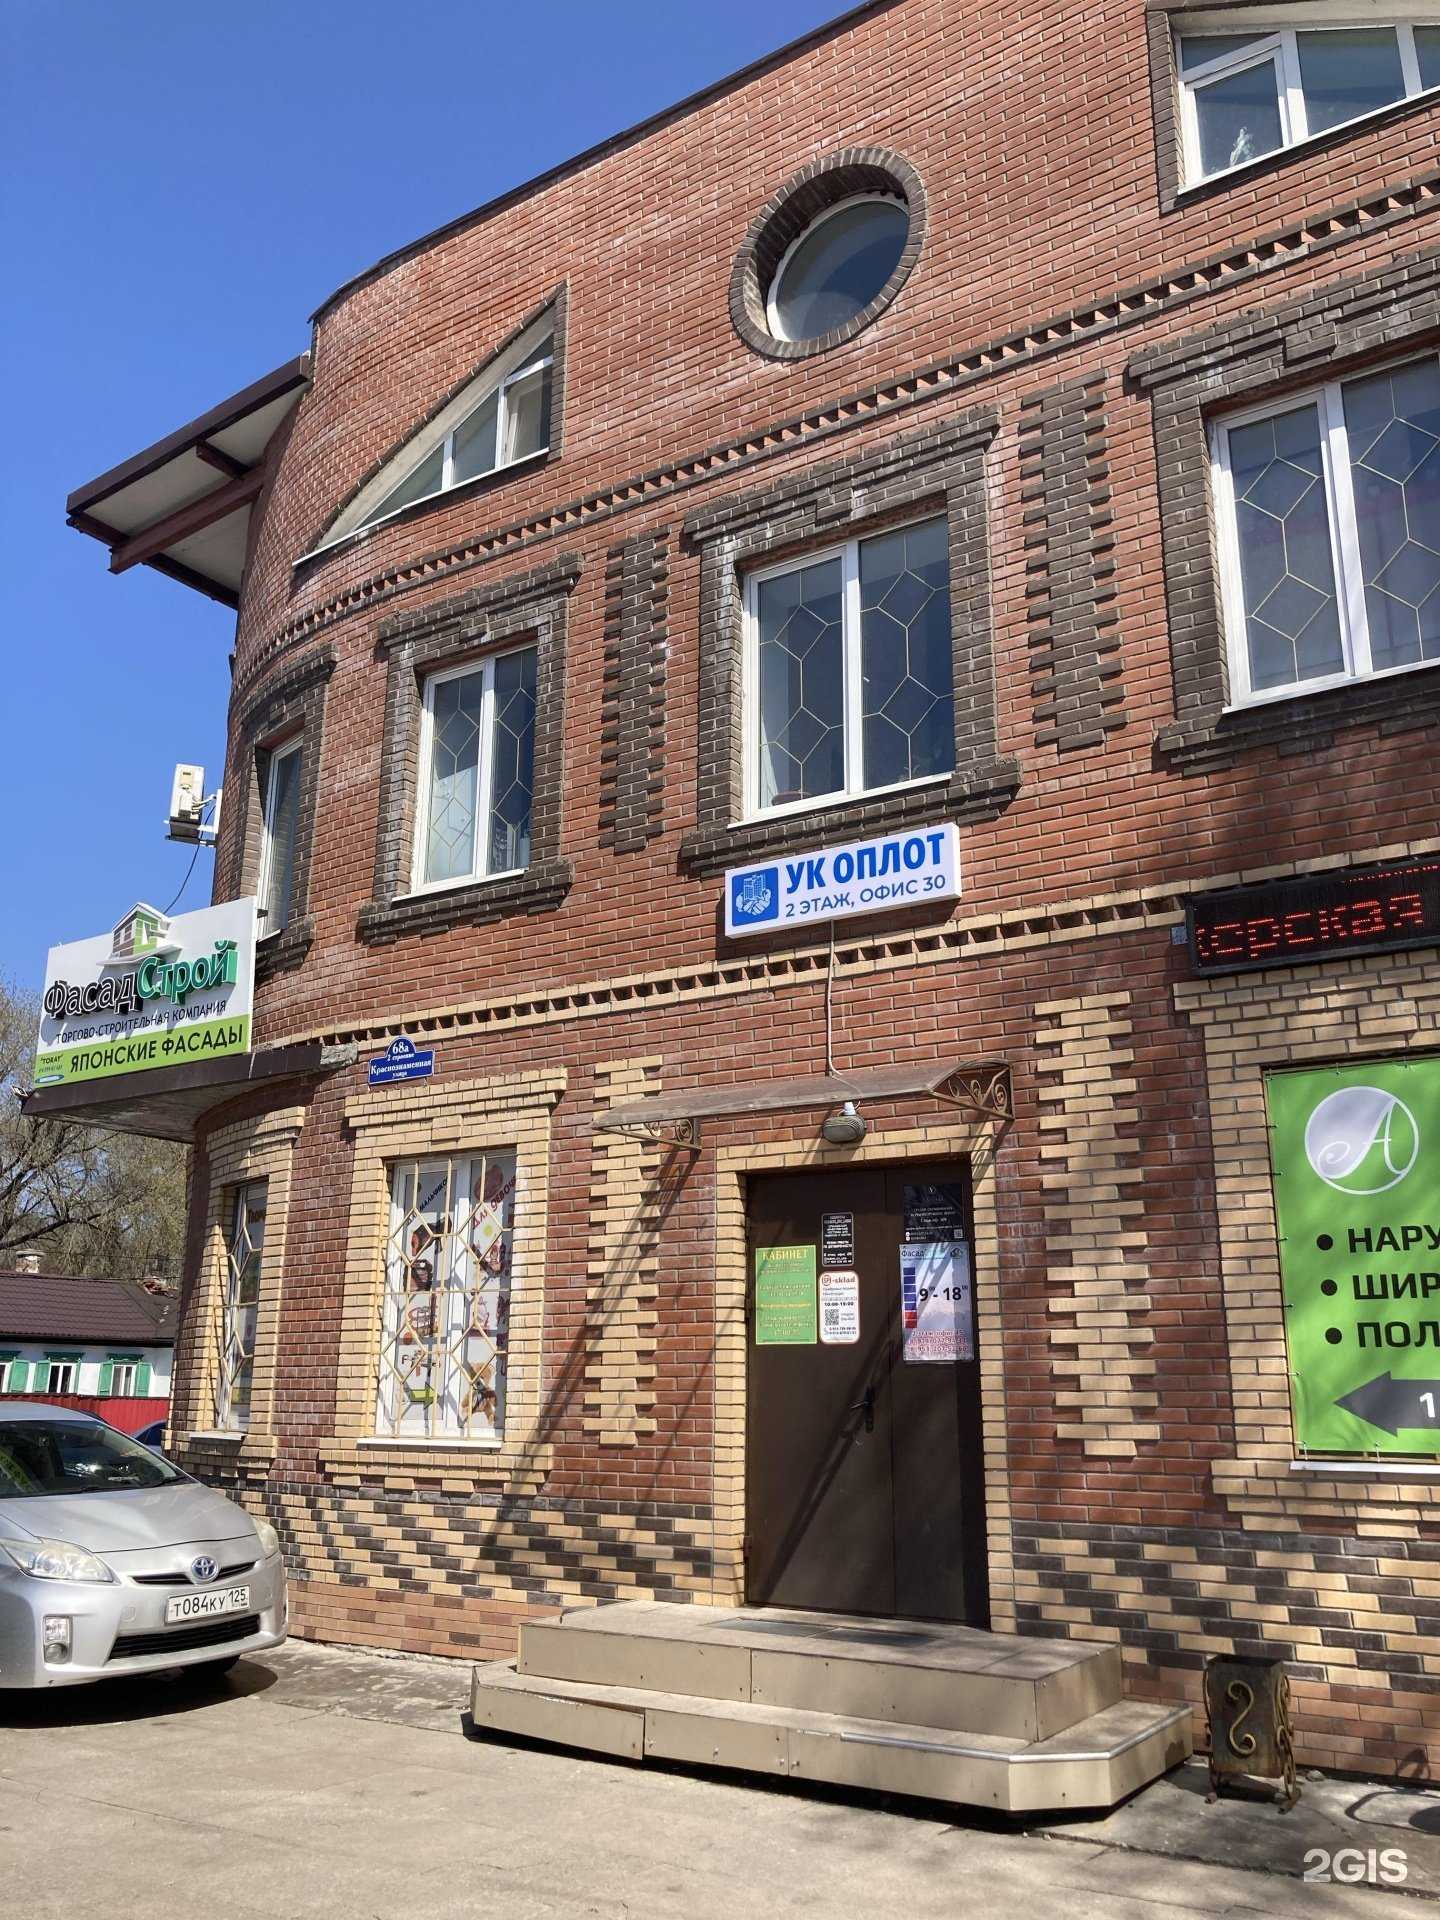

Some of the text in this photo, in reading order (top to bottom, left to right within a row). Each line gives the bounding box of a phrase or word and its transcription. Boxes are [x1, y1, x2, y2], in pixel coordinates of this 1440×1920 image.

[786, 832, 945, 894] УК ОПЛОТ
[785, 874, 946, 918] 2 ЭТАЖ, ОФИС 30
[56, 1000, 226, 1044] ТОРГОВО-СТРОИТЕЛЬНАЯ КОМПАНИЯ
[71, 1024, 243, 1073] ЯПОНСКИЕ ФАСАДЫ
[762, 1248, 808, 1261] КАБИНЕТ
[228, 1588, 246, 1604] 125
